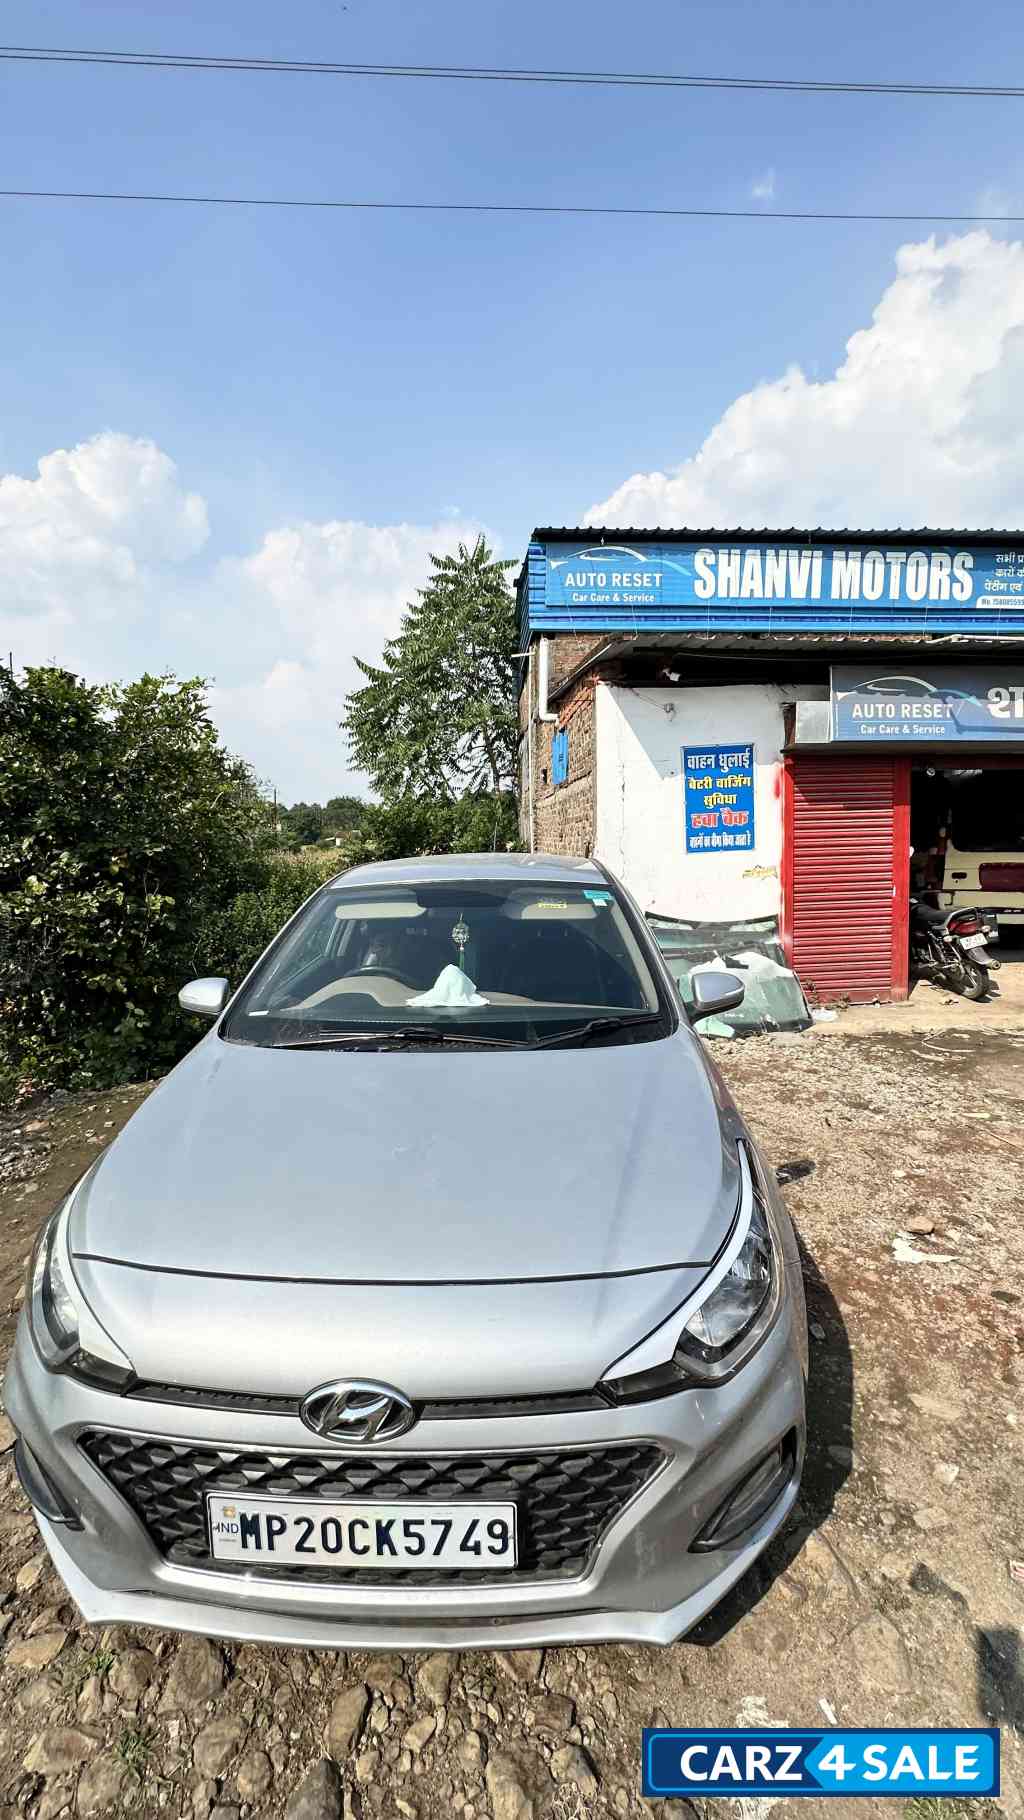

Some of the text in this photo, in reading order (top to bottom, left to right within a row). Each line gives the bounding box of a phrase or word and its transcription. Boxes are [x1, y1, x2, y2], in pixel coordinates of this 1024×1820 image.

[565, 572, 663, 587] AUTO RESET
[693, 548, 974, 601] SHANVI MOTORS
[572, 591, 656, 602] Car Care & Service
[852, 703, 954, 719] AUTO RESET
[860, 723, 945, 735] Car Care & Service
[687, 754, 716, 769] वाहन
[691, 813, 718, 828] हवा
[239, 1512, 510, 1557] MP20CK5749
